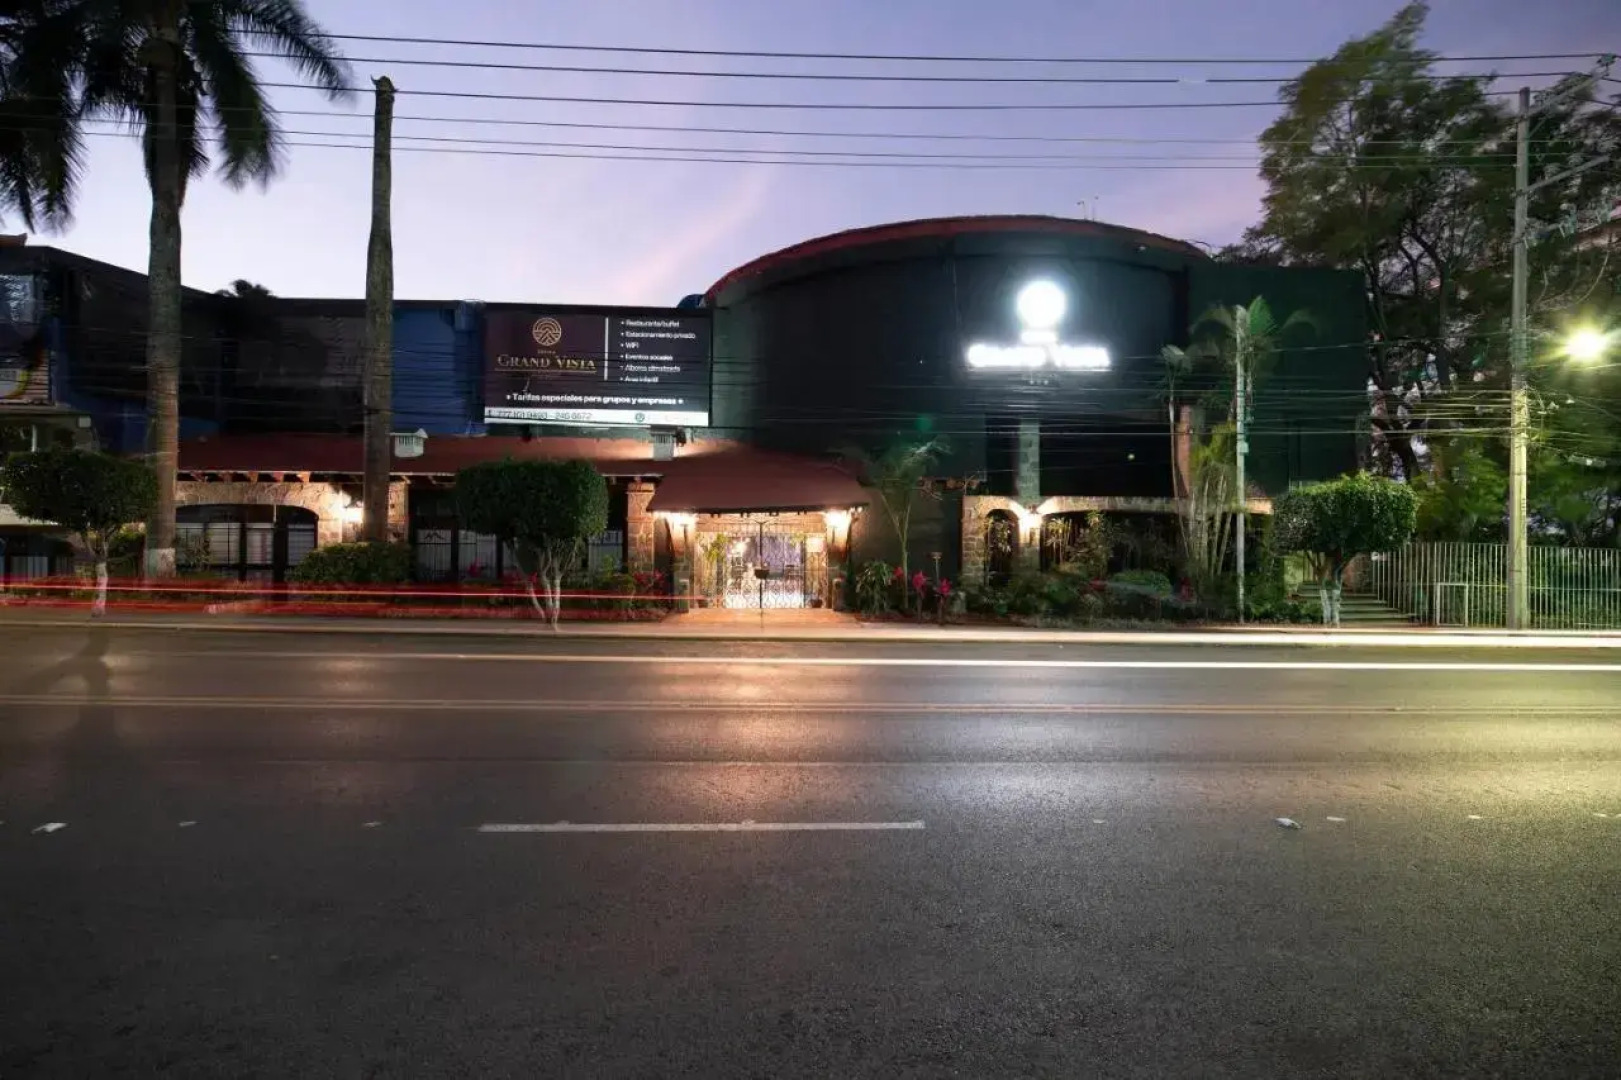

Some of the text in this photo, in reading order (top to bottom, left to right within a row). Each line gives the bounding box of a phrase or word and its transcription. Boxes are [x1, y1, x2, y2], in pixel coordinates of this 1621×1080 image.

[512, 393, 541, 401] Tarifas
[541, 394, 583, 403] especiales
[602, 396, 631, 404] grupos
